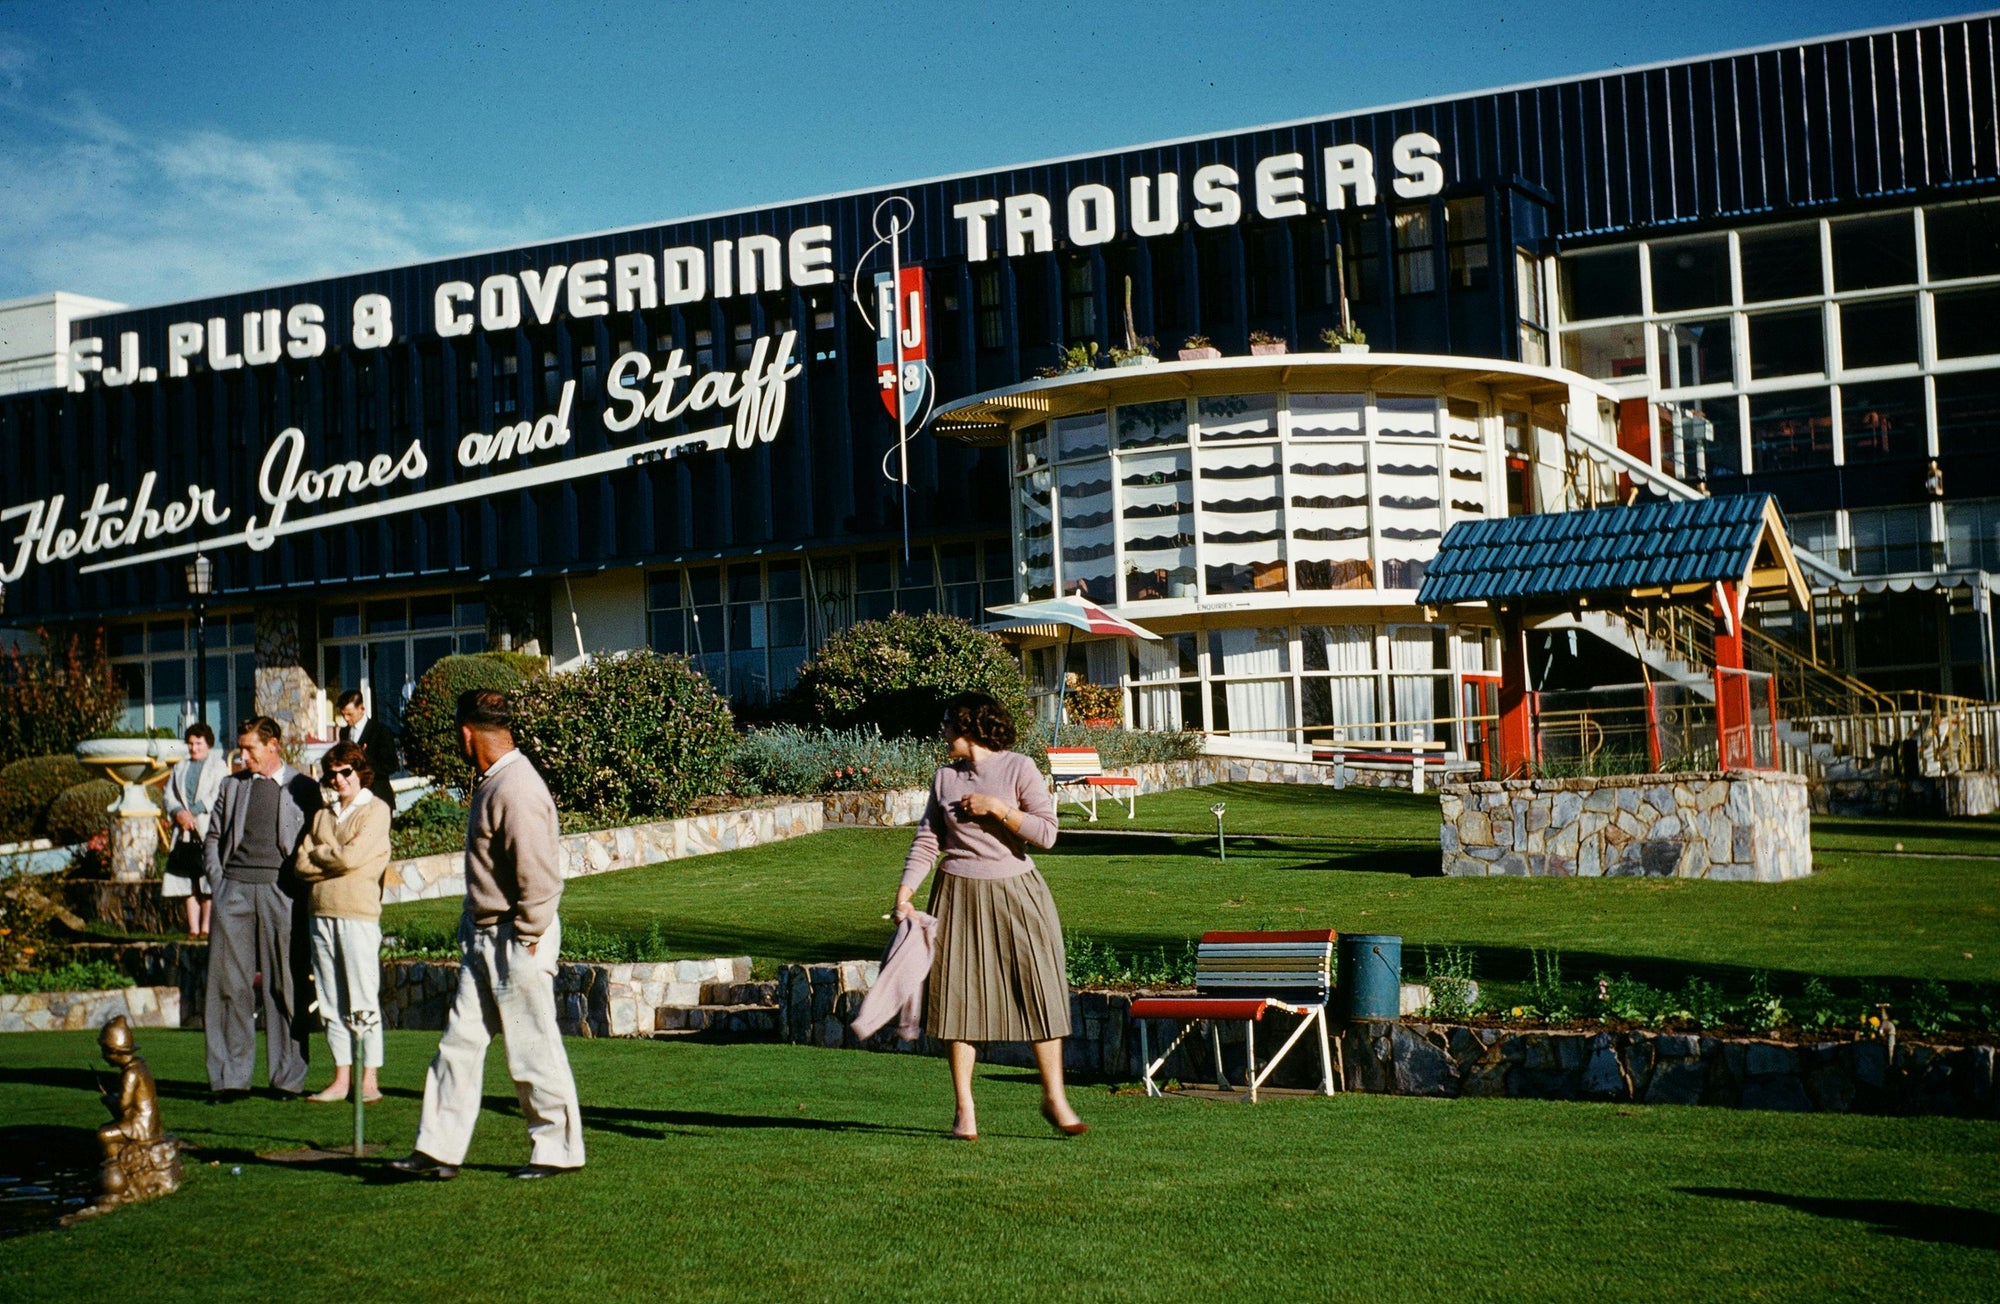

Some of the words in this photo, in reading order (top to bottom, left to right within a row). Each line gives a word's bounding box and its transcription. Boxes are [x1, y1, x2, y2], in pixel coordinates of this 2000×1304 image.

[168, 302, 327, 378] PLUS
[352, 293, 394, 350] 8
[434, 224, 835, 338] COVERDINE
[952, 131, 1443, 263] TROUSERS
[0, 471, 231, 583] Fletcher
[245, 427, 428, 551] Jones
[457, 379, 577, 468] and
[603, 329, 803, 449] Staff
[1196, 601, 1233, 611] ENQUIRIES
